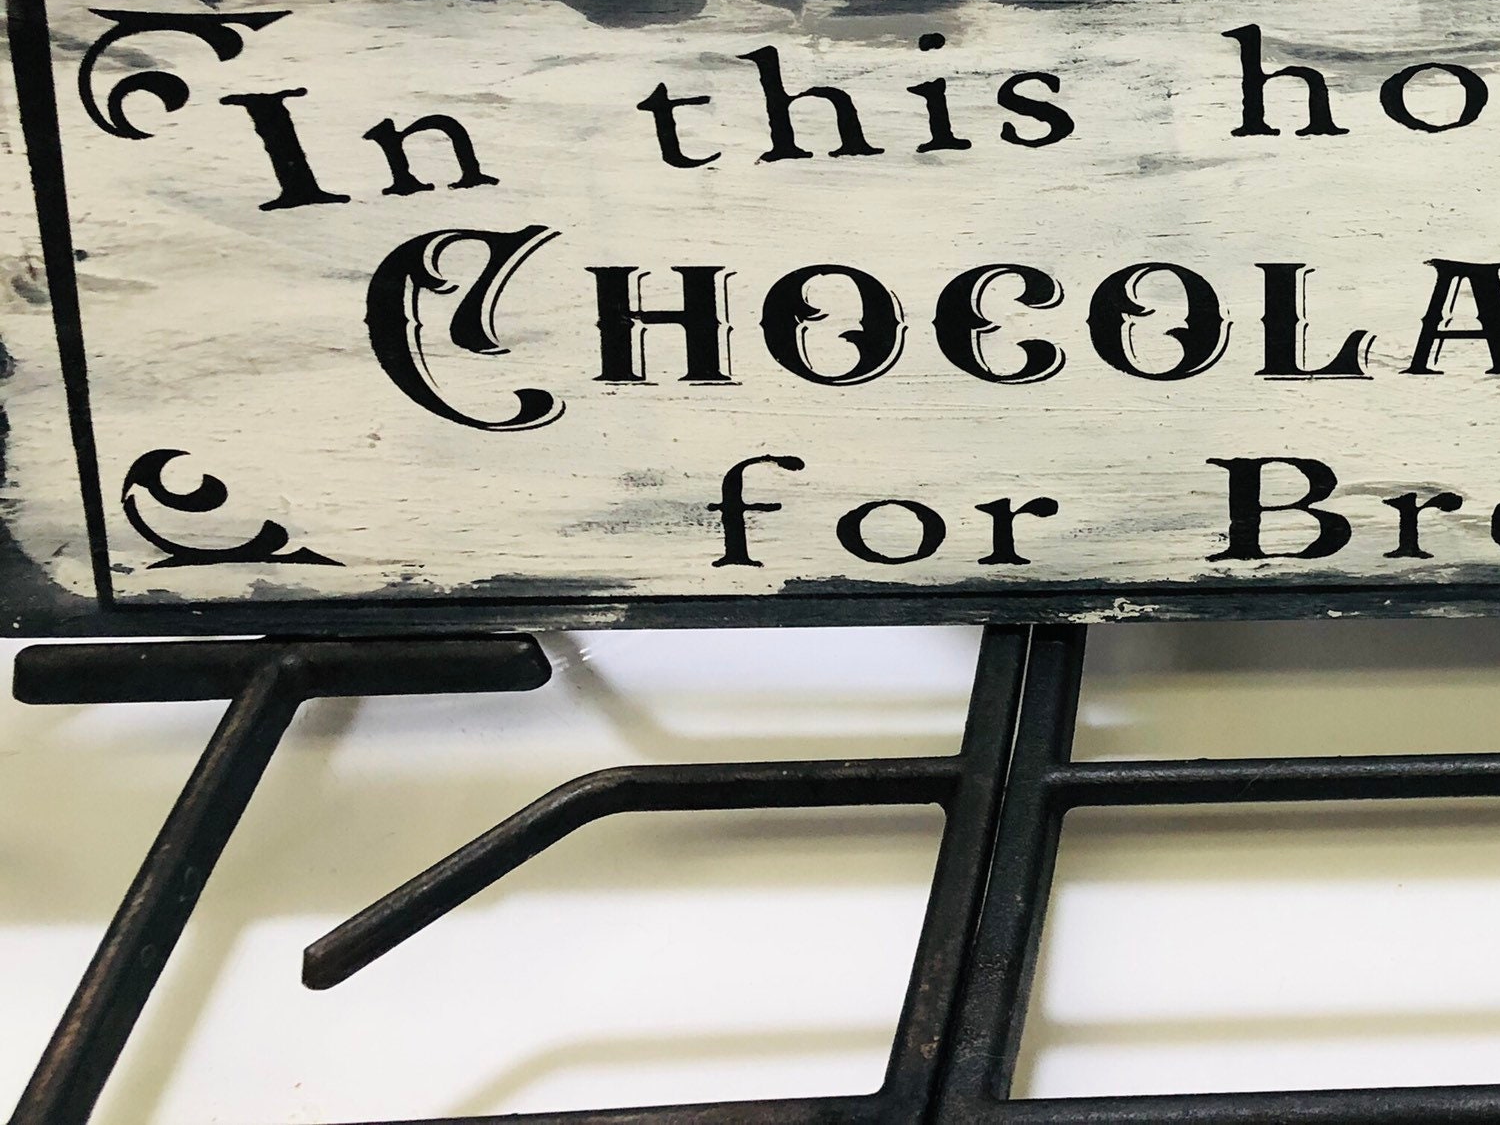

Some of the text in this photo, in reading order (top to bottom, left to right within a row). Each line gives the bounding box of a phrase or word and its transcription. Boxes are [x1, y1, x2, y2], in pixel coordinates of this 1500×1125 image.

[219, 86, 500, 211] In
[636, 31, 1075, 169] this
[706, 452, 1060, 569] for
